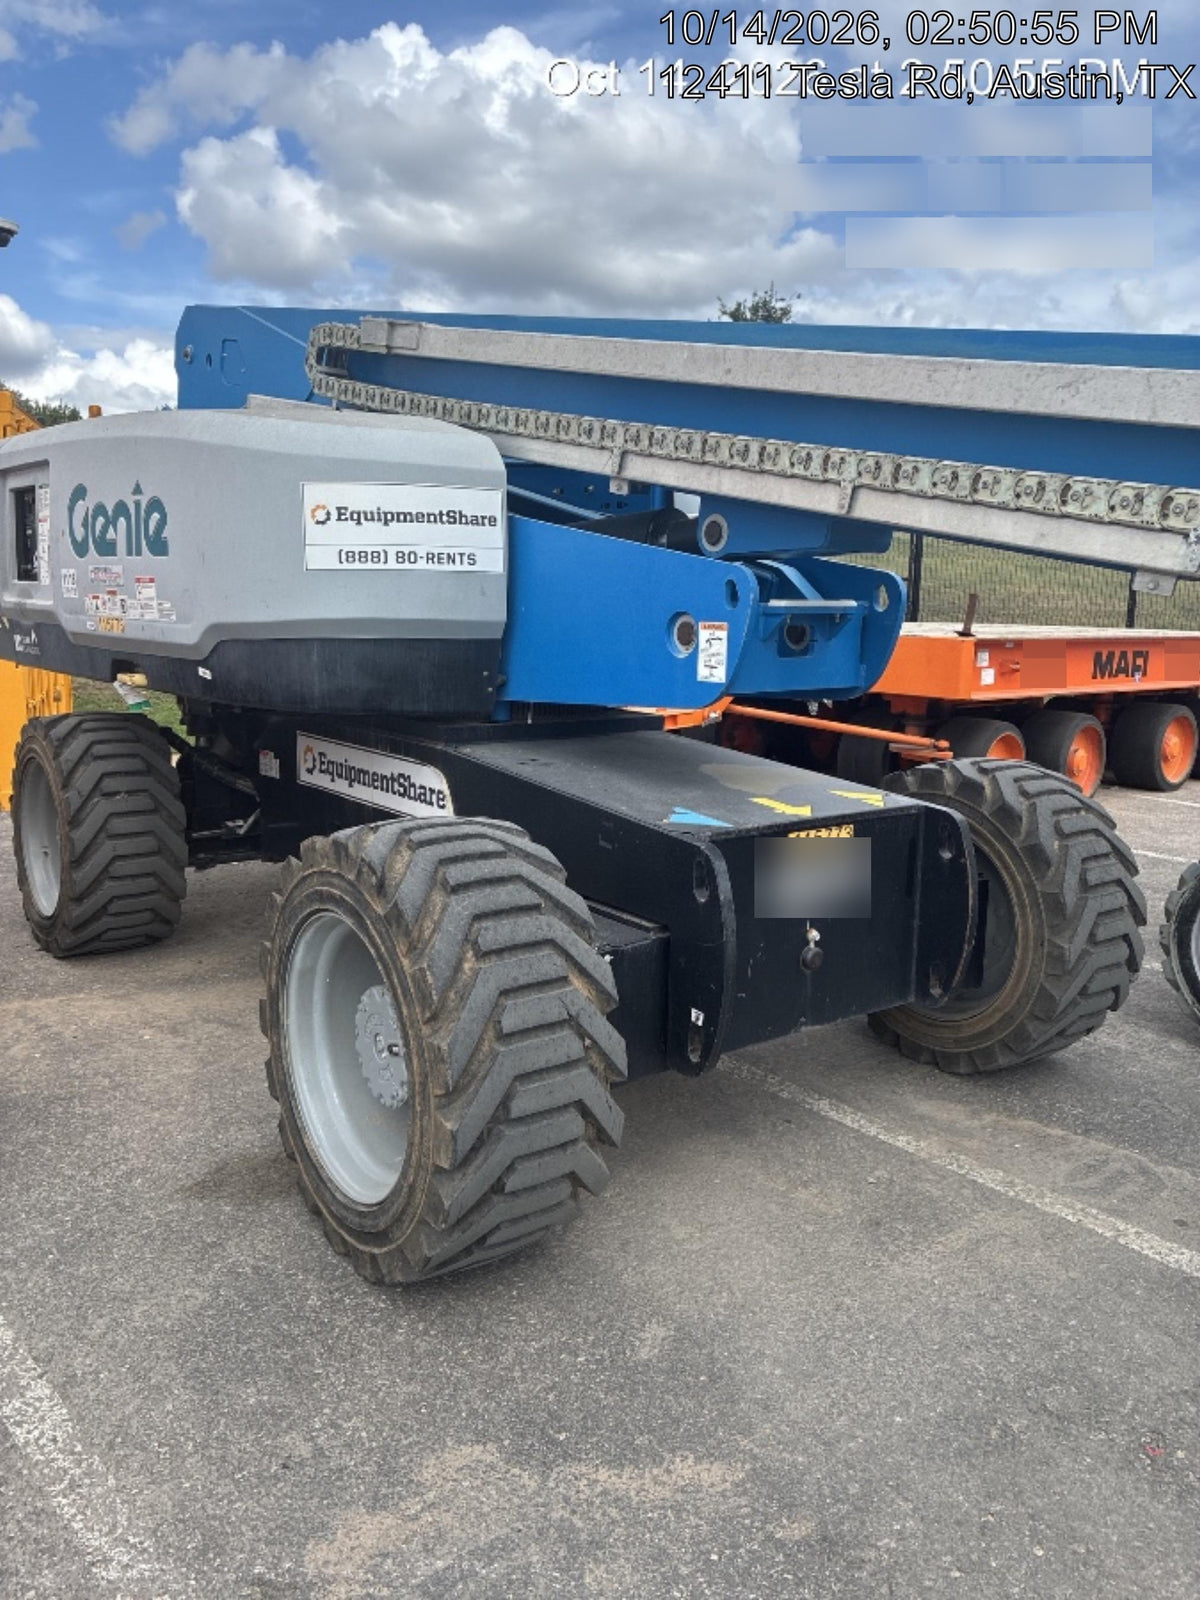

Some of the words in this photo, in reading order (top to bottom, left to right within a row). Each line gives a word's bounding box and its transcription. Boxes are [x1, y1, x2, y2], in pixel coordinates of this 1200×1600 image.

[68, 479, 169, 559] Genie
[335, 506, 498, 527] EquipmentShare
[338, 549, 388, 564] (888)
[395, 550, 477, 566] 80-RENTS
[1091, 650, 1149, 679] MAFI
[318, 752, 446, 809] EquipmentShare
